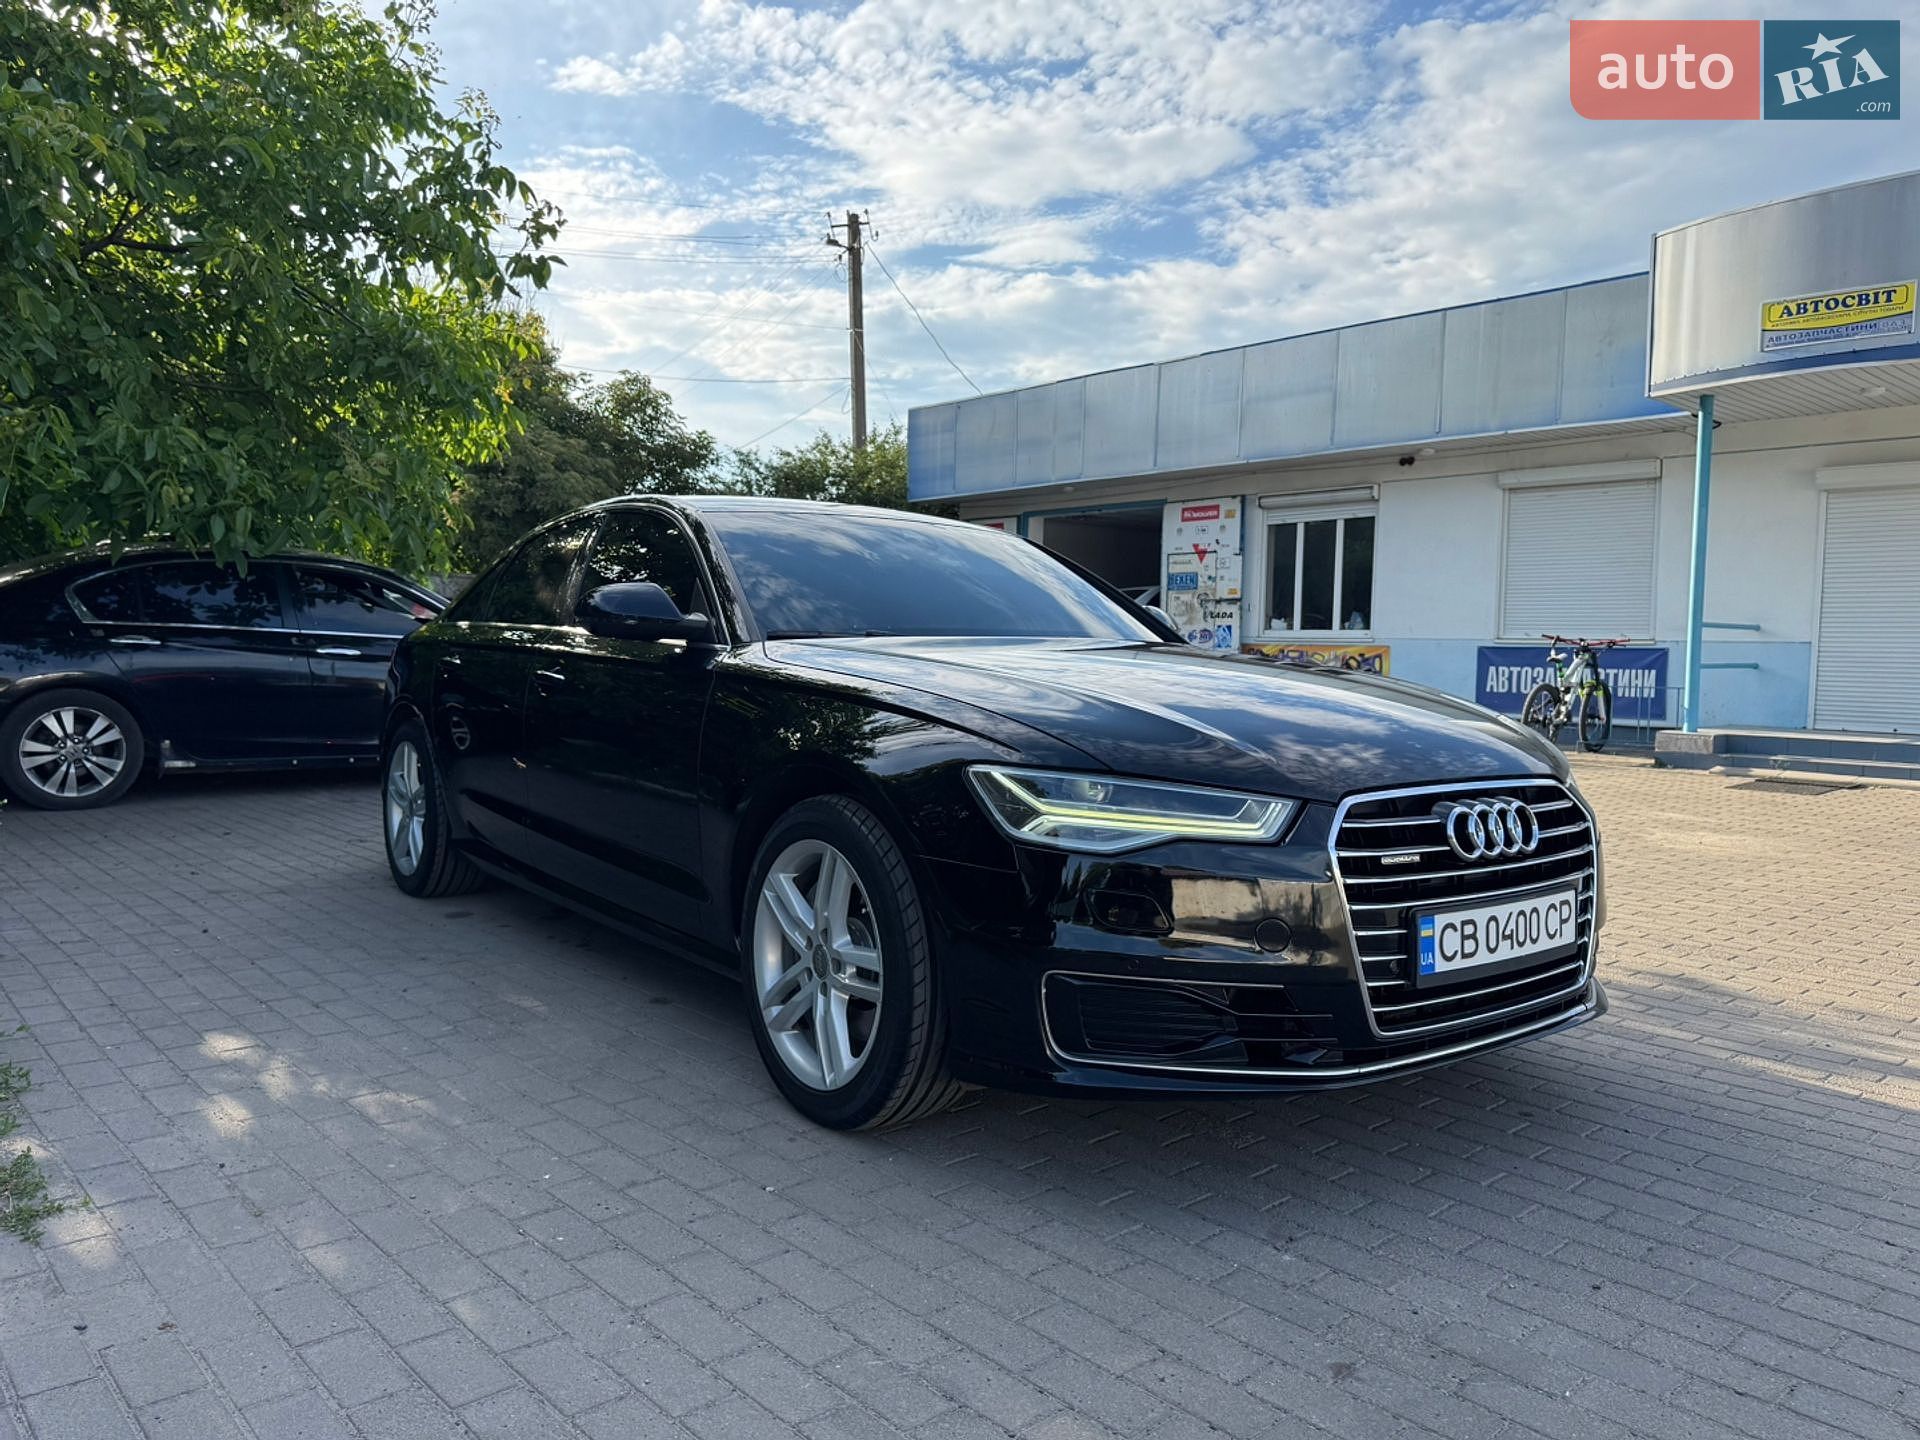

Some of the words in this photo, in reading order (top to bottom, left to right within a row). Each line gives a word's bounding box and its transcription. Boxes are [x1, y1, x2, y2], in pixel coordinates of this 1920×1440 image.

[1778, 289, 1897, 318] АВТОСВІТ
[1768, 322, 1877, 344] АВТОЗАПЧАСТИНИ
[1486, 665, 1656, 698] АВТОЗААТИНИ
[1438, 918, 1479, 963] CB
[1485, 906, 1541, 956] 0400
[1545, 900, 1572, 941] CP
[1420, 951, 1434, 965] UA
